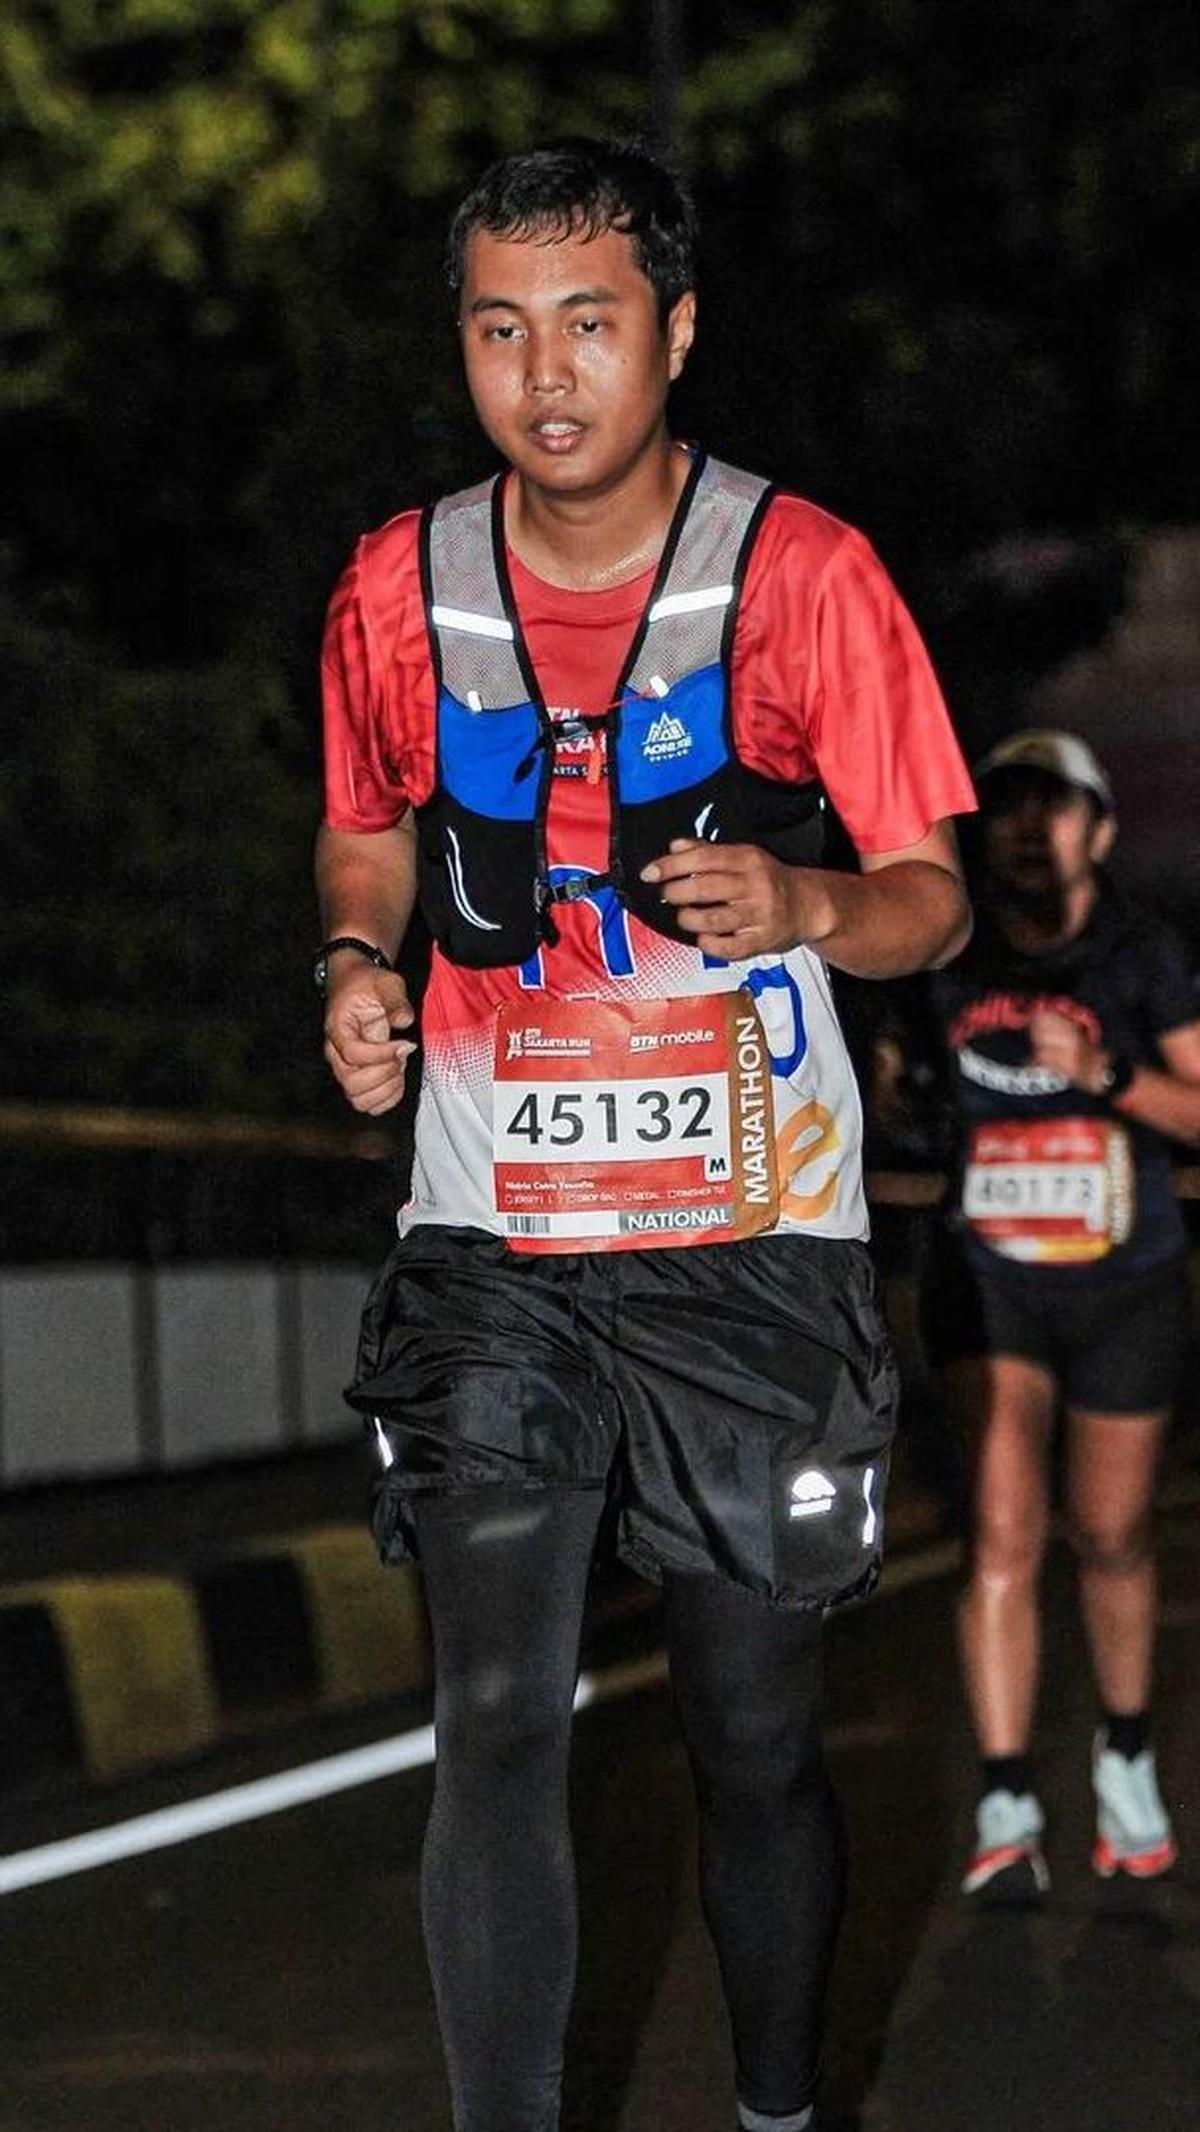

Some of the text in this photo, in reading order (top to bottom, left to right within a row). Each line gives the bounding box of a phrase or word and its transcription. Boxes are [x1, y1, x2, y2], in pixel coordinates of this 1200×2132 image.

[630, 1029, 715, 1048] BTN mobile
[506, 1087, 713, 1146] 45132
[736, 1017, 770, 1204] MARATHON
[709, 1157, 727, 1173] M
[627, 1207, 730, 1231] NATIONAL
